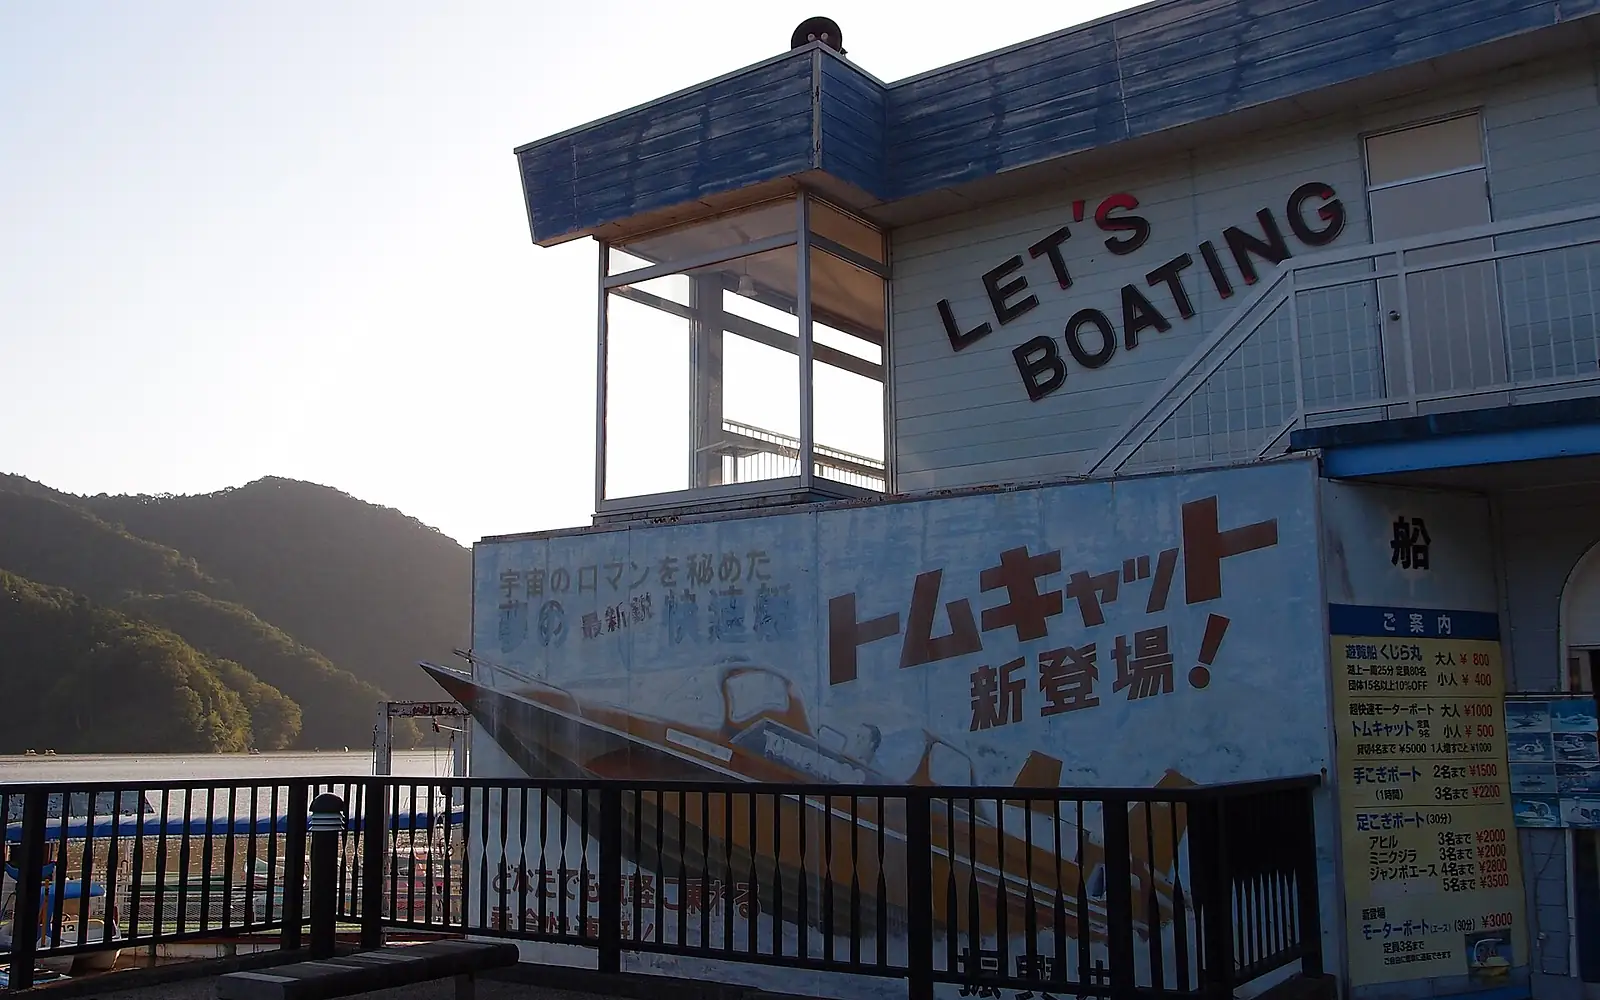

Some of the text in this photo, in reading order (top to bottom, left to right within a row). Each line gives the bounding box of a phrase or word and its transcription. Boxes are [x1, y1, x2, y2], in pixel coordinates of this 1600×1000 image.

[937, 193, 1150, 352] LET'S
[1012, 182, 1346, 401] BOATING
[1390, 516, 1431, 570] 船
[499, 550, 771, 599] 宇宙のロマンを秘めた
[829, 495, 1278, 685] トムキャット
[1383, 612, 1452, 635] ご案内
[1381, 644, 1422, 661] くじら丸
[1435, 652, 1456, 666] 大人
[1438, 673, 1458, 687] 小人
[1349, 703, 1435, 716] 超快速モーターボート
[1441, 704, 1493, 718] 大人 ¥1000
[1352, 720, 1414, 737] トムキャット
[1443, 725, 1462, 739] 小人
[1399, 743, 1427, 754] ¥5000
[1353, 765, 1421, 785] 手こぎボート
[1433, 764, 1497, 779] 2名まで ¥1500
[1435, 785, 1500, 800] 3名まで ¥2200
[1356, 812, 1424, 831] 足こぎボート
[1369, 835, 1399, 850] アヒル
[1438, 829, 1506, 846] 3名まで ¥2000
[1369, 849, 1417, 865] ミニクジラ
[1439, 844, 1506, 861] 3名まで ¥2000
[1370, 864, 1438, 881] ジャンボエース
[1441, 859, 1507, 877] 4名まで ¥2800
[1443, 873, 1509, 892] 5名まで ¥3500
[1362, 918, 1429, 940] モーターボート
[1481, 912, 1513, 928] ¥3000
